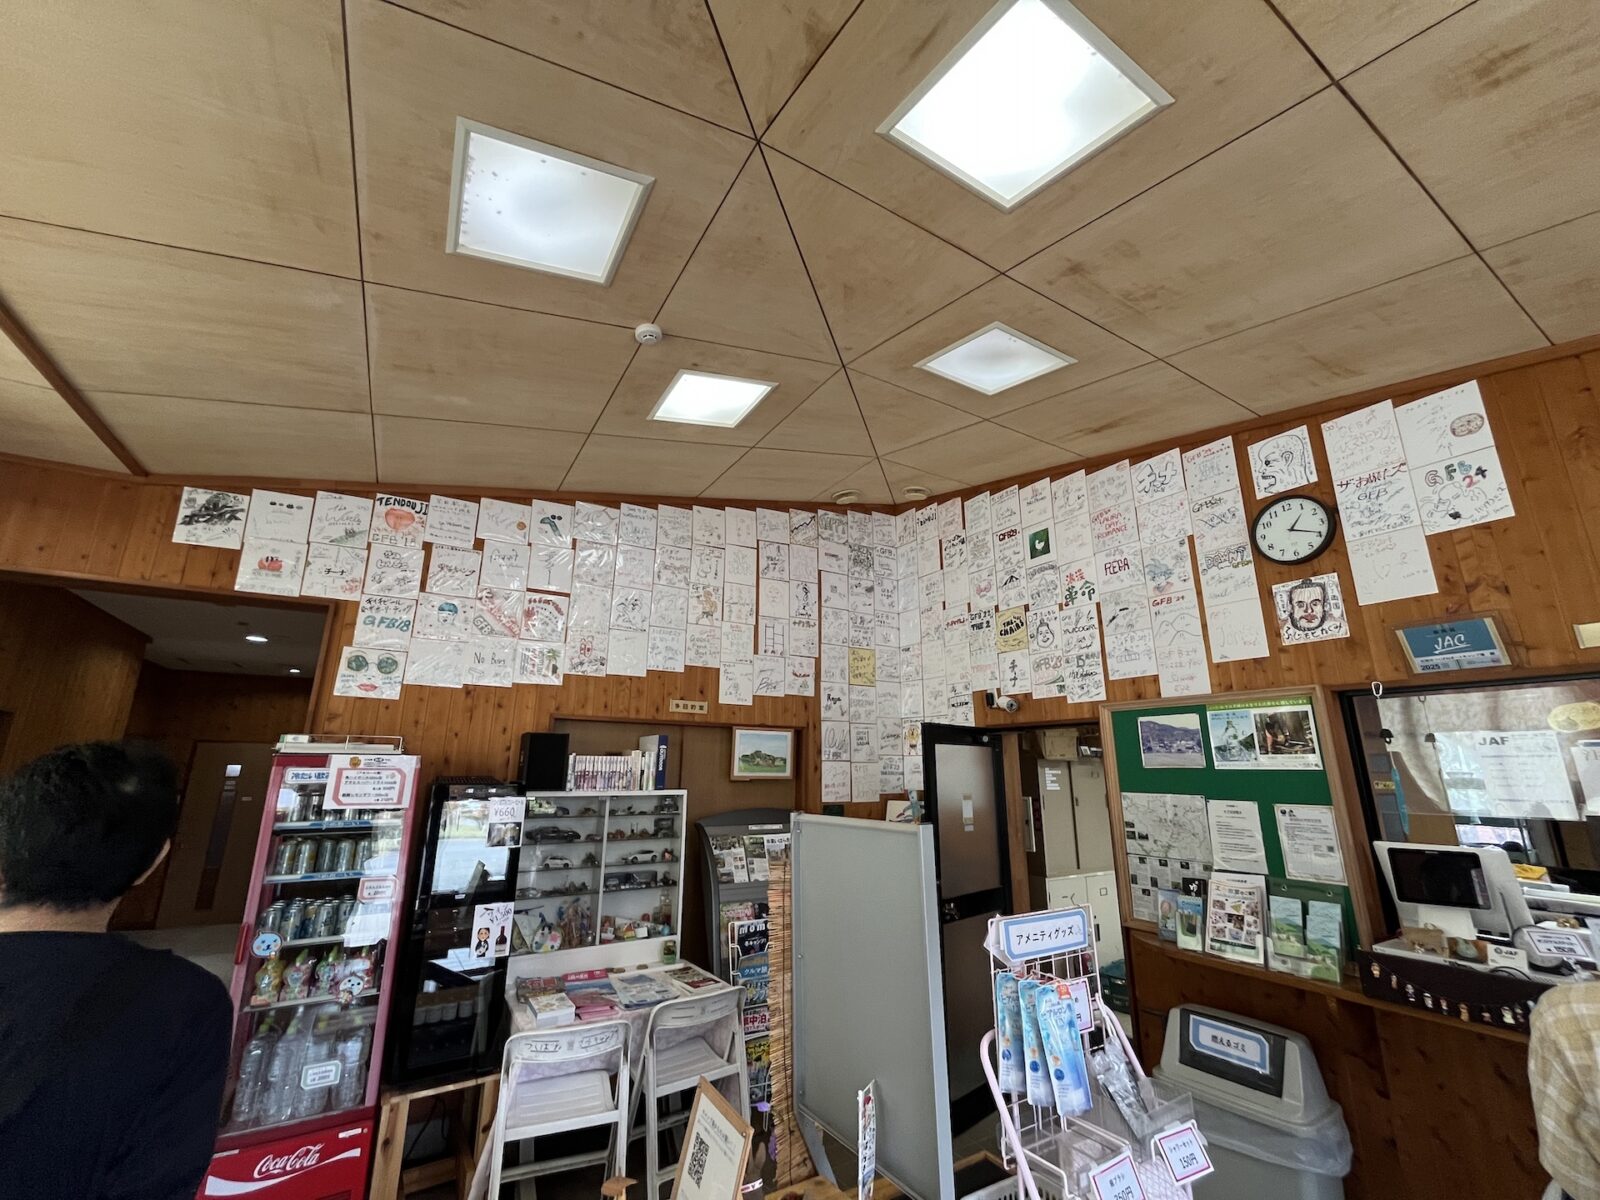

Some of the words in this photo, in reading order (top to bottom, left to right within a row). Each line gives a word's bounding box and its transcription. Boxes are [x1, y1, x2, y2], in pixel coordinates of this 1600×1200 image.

[376, 497, 428, 515] TENDOUJI
[1281, 503, 1292, 512] 12
[1299, 503, 1304, 511] 1
[1268, 511, 1278, 519] 11
[1311, 508, 1318, 516] 2
[1262, 521, 1272, 529] 10
[1318, 518, 1325, 526] 3
[1267, 543, 1274, 551] 8
[1307, 542, 1314, 550] 5
[1279, 549, 1285, 557] 7
[1434, 634, 1465, 650] JAC
[1478, 736, 1509, 746] JAF
[739, 923, 769, 935] mom
[1016, 925, 1074, 945] アメニティグッズ
[1211, 1034, 1247, 1053] 燃えるゴミ
[253, 1142, 325, 1178] Coca-Cola
[1179, 1152, 1199, 1169] 150円
